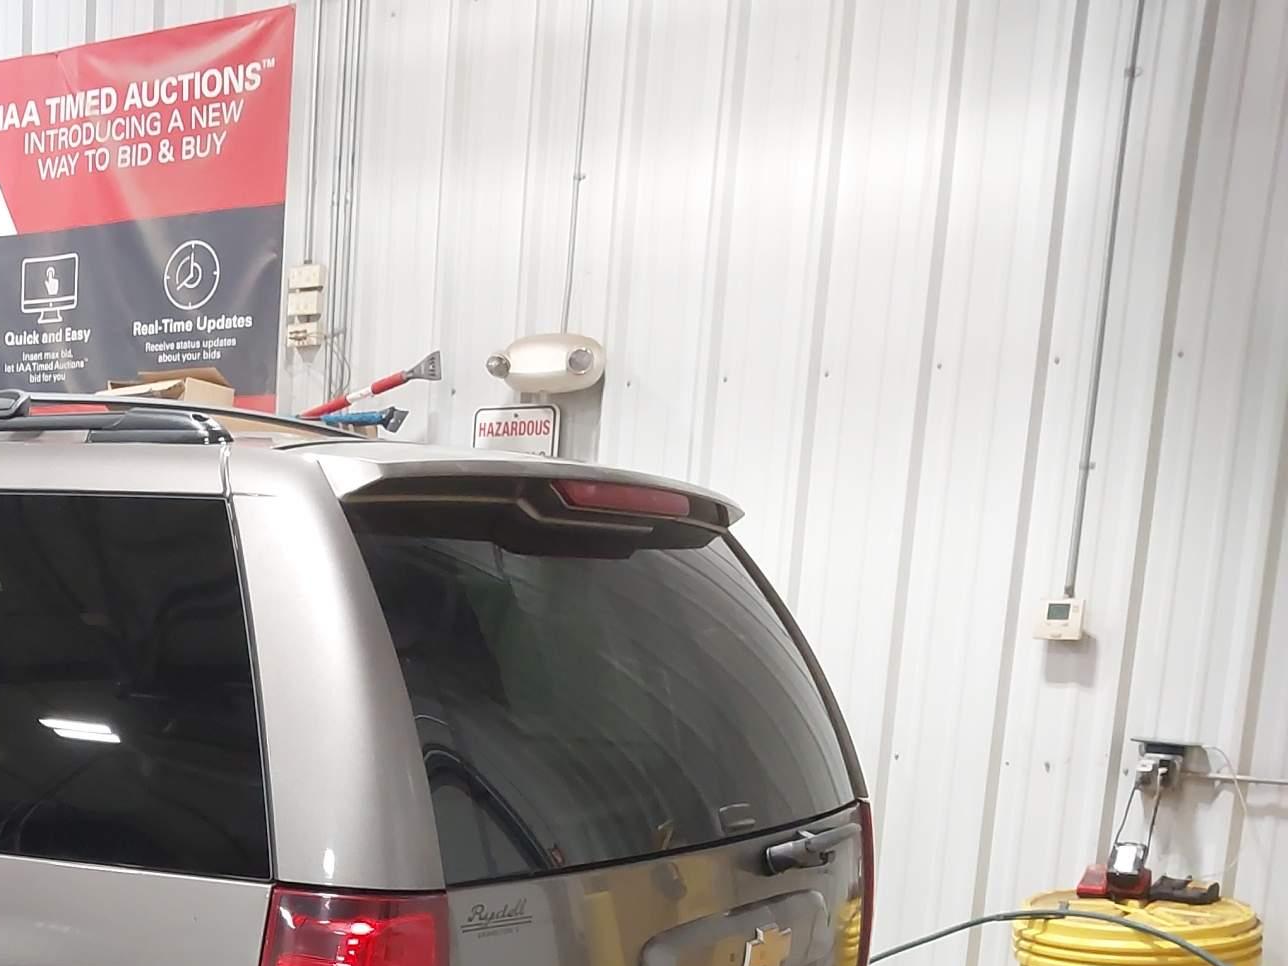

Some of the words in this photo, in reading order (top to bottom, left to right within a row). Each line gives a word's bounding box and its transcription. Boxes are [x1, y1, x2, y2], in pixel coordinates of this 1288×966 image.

[46, 87, 117, 124] TIMED
[24, 112, 161, 154] INTRODUCING
[168, 108, 184, 133] A
[191, 99, 244, 130] NEW
[37, 153, 79, 180] WAY
[84, 148, 110, 173] TO
[117, 143, 152, 168] BID
[158, 139, 174, 163] &
[181, 132, 227, 160] BUY
[133, 319, 193, 336] Real-Time
[197, 315, 253, 333] Updates
[5, 331, 40, 346] Quick
[42, 328, 63, 344] and
[65, 328, 91, 343] Easy
[145, 341, 175, 353] Receive
[176, 340, 200, 350] status
[203, 338, 237, 349] updates
[22, 352, 43, 361] Insert
[158, 352, 180, 363] about
[182, 352, 201, 363] your
[203, 350, 221, 360] bids
[4, 363, 15, 373] let
[16, 363, 32, 373] IAA
[32, 361, 54, 371] Timed
[29, 374, 41, 383] bid
[42, 373, 52, 383] for
[52, 373, 66, 383] you
[478, 419, 551, 438] HAZARDOUS
